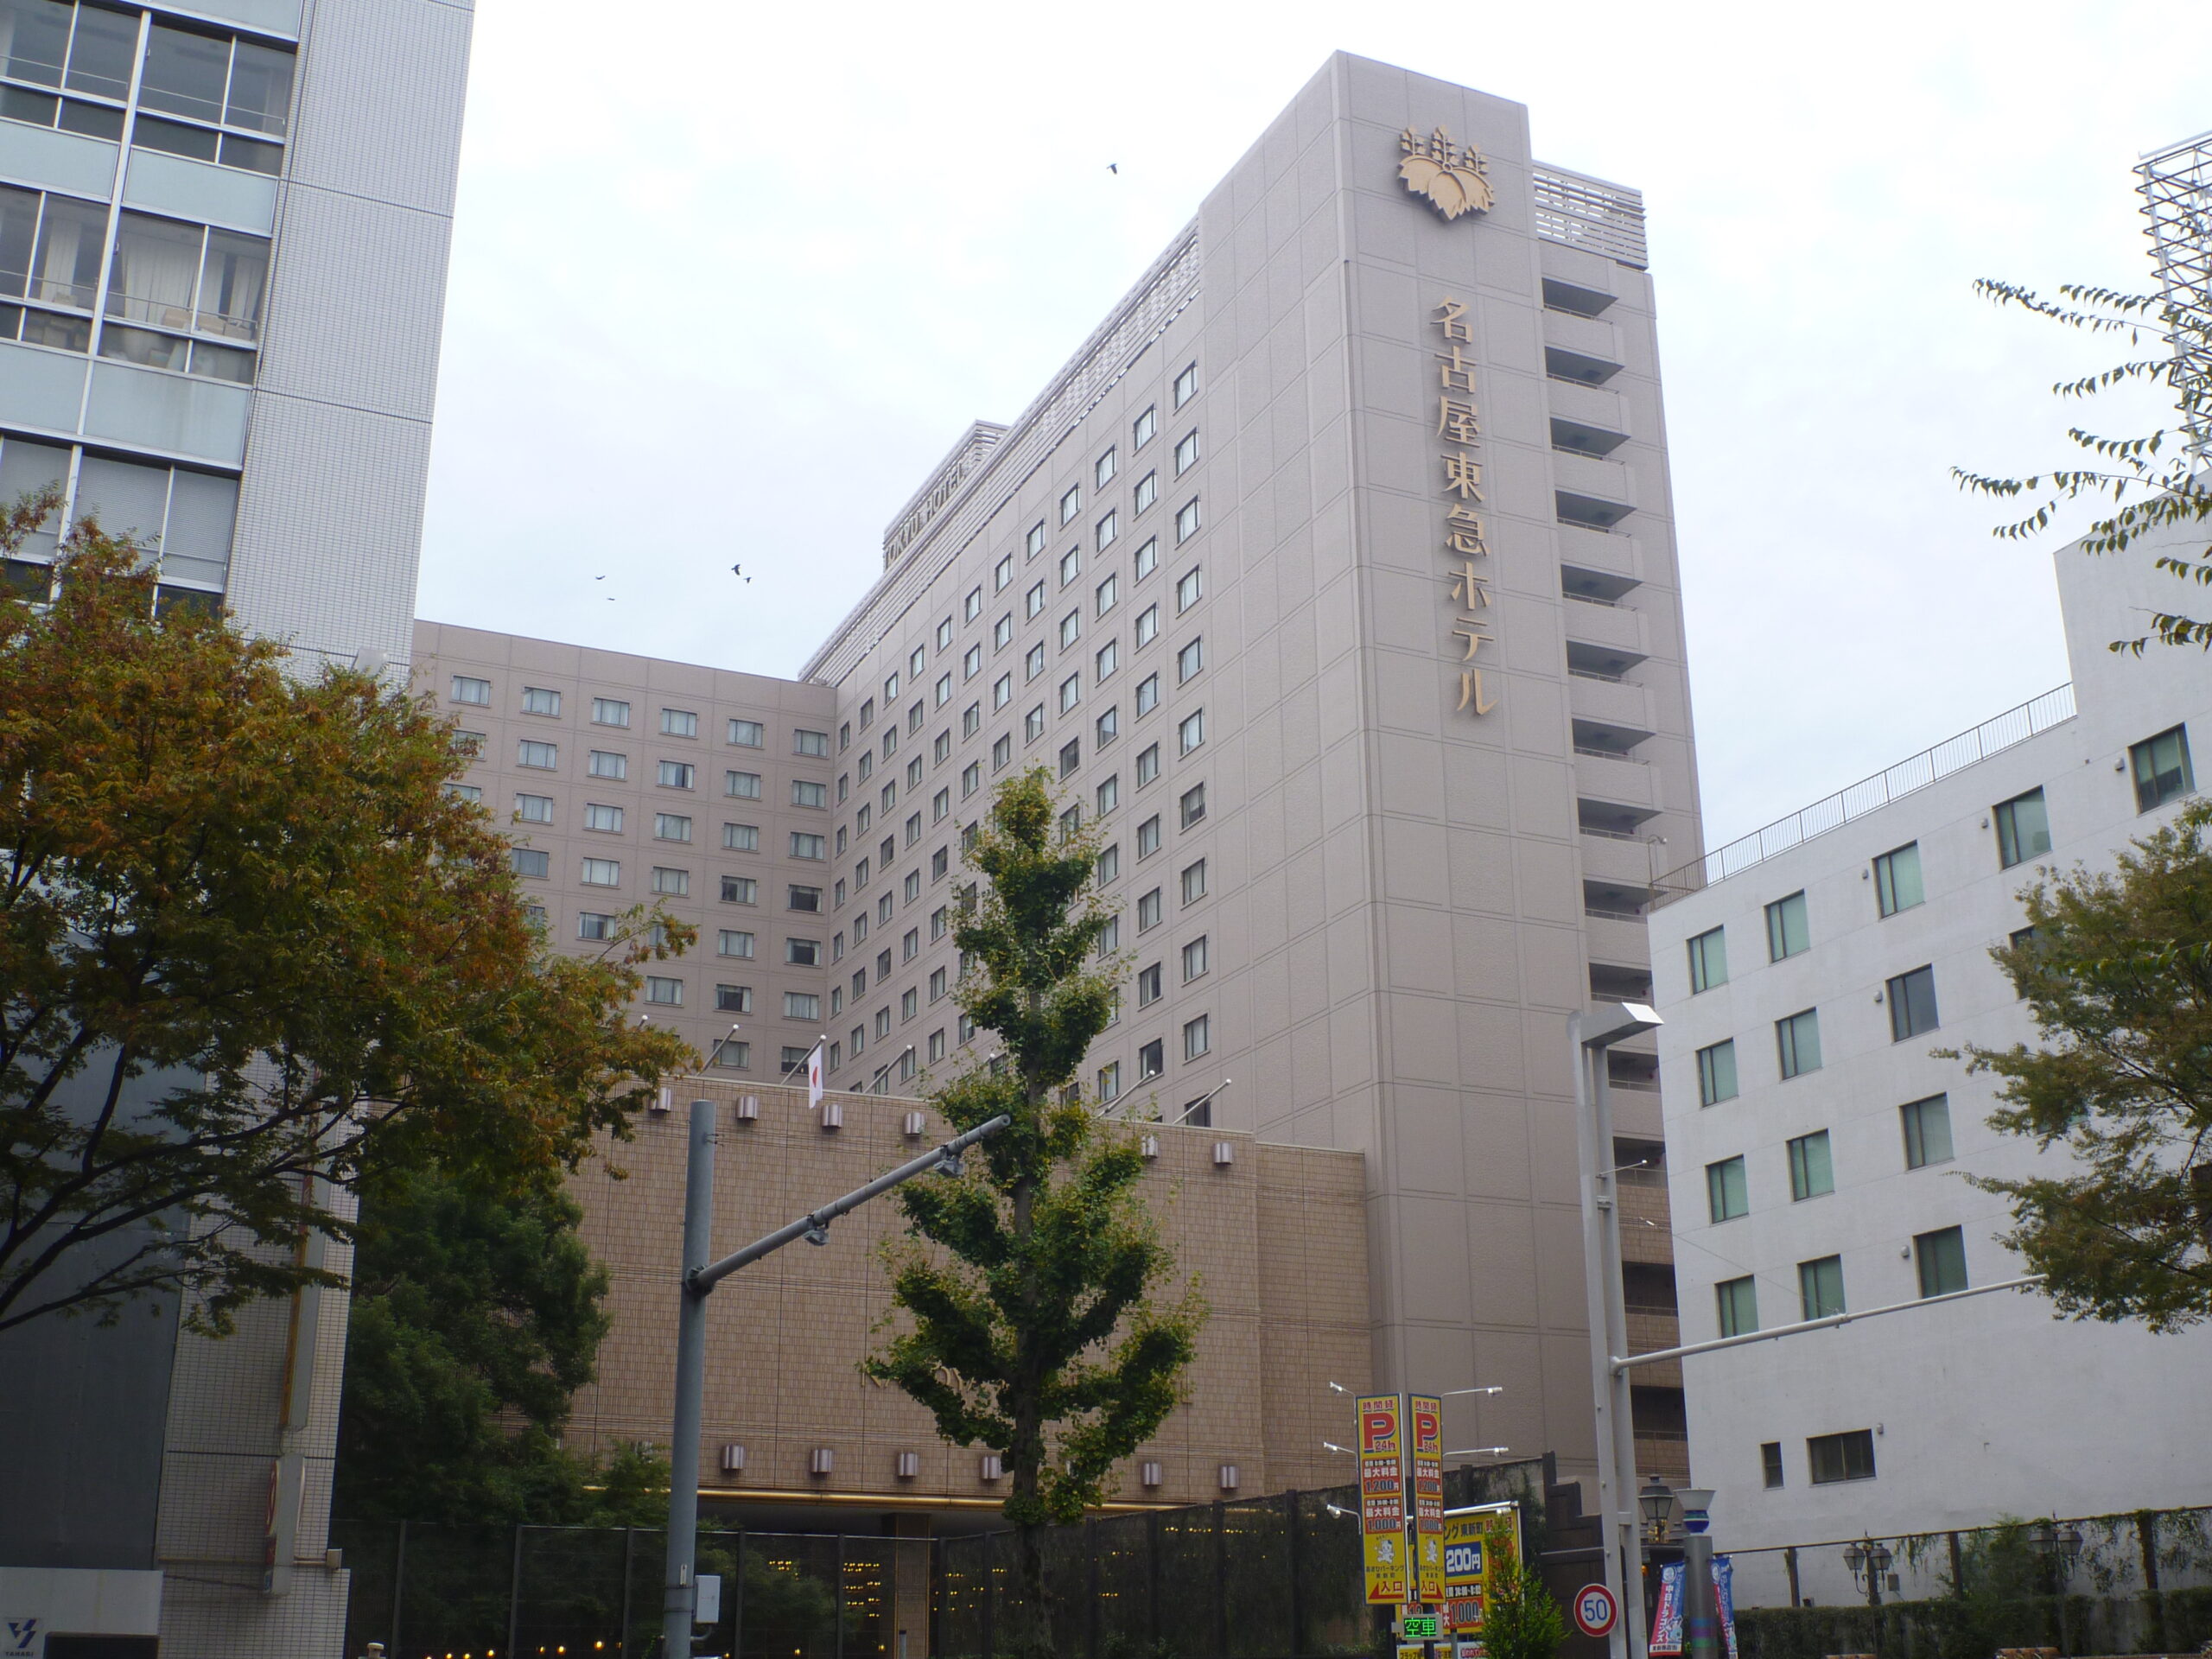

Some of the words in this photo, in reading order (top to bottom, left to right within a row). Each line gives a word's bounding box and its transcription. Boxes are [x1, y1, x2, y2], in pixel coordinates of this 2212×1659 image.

[1430, 296, 1499, 715] 名古屋東急ホテル
[883, 512, 921, 570] TOKYU
[926, 462, 966, 522] HOTEL
[1363, 1412, 1396, 1453] P
[1415, 1412, 1439, 1452] P
[1375, 1440, 1396, 1452] 24h
[1424, 1441, 1439, 1453] 24h
[1363, 1466, 1398, 1478] 最大料金
[1417, 1466, 1440, 1479] 最大料金
[1366, 1506, 1400, 1518] 最大料金
[1418, 1507, 1441, 1519] 最大料金
[1382, 1580, 1403, 1592] 入口
[1421, 1580, 1437, 1592] 入口
[1584, 1599, 1608, 1622] 50
[1656, 1585, 1675, 1643] 中日ドラゴンズ
[1404, 1617, 1438, 1637] 空車
